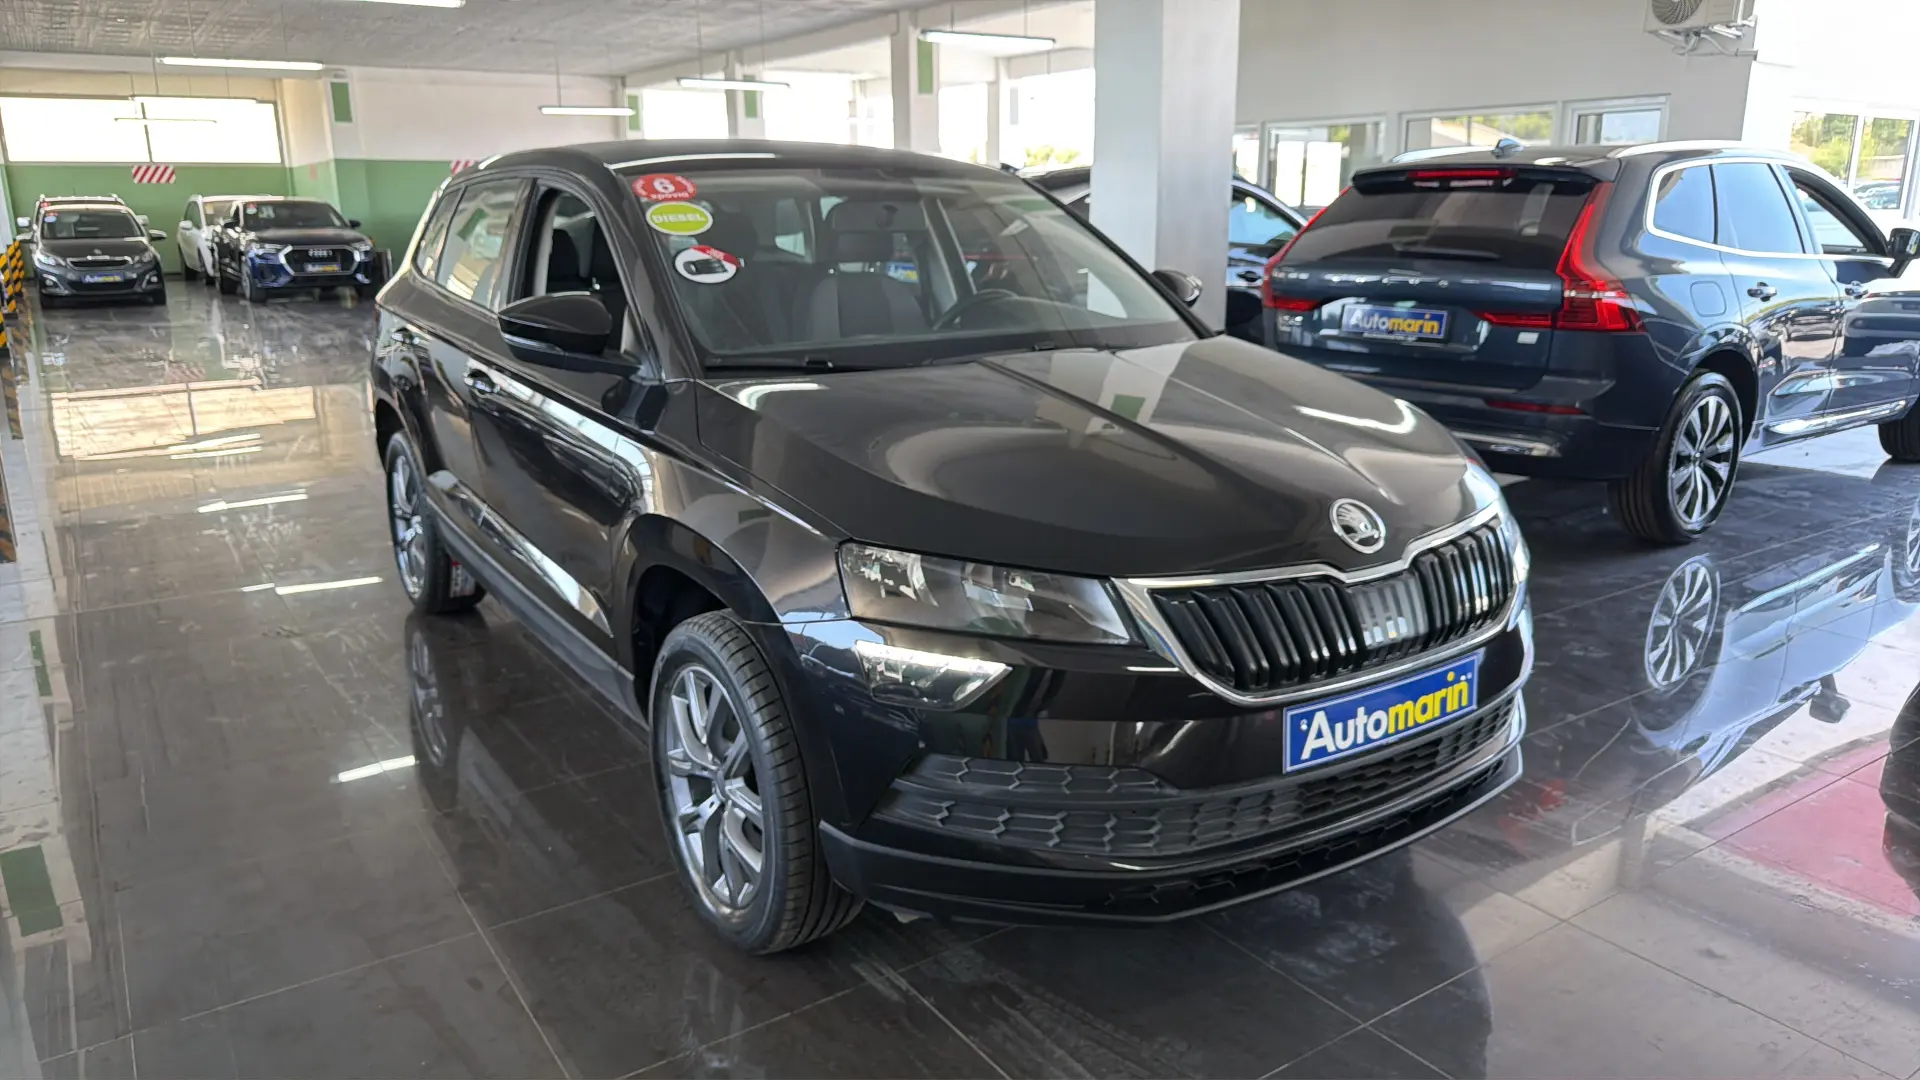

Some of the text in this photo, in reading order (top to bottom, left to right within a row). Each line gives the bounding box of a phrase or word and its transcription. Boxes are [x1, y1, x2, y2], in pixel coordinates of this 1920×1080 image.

[653, 178, 675, 194] 6
[652, 212, 706, 224] DIESEL
[1349, 308, 1440, 335] Automarin
[1300, 671, 1469, 760] Automarin
